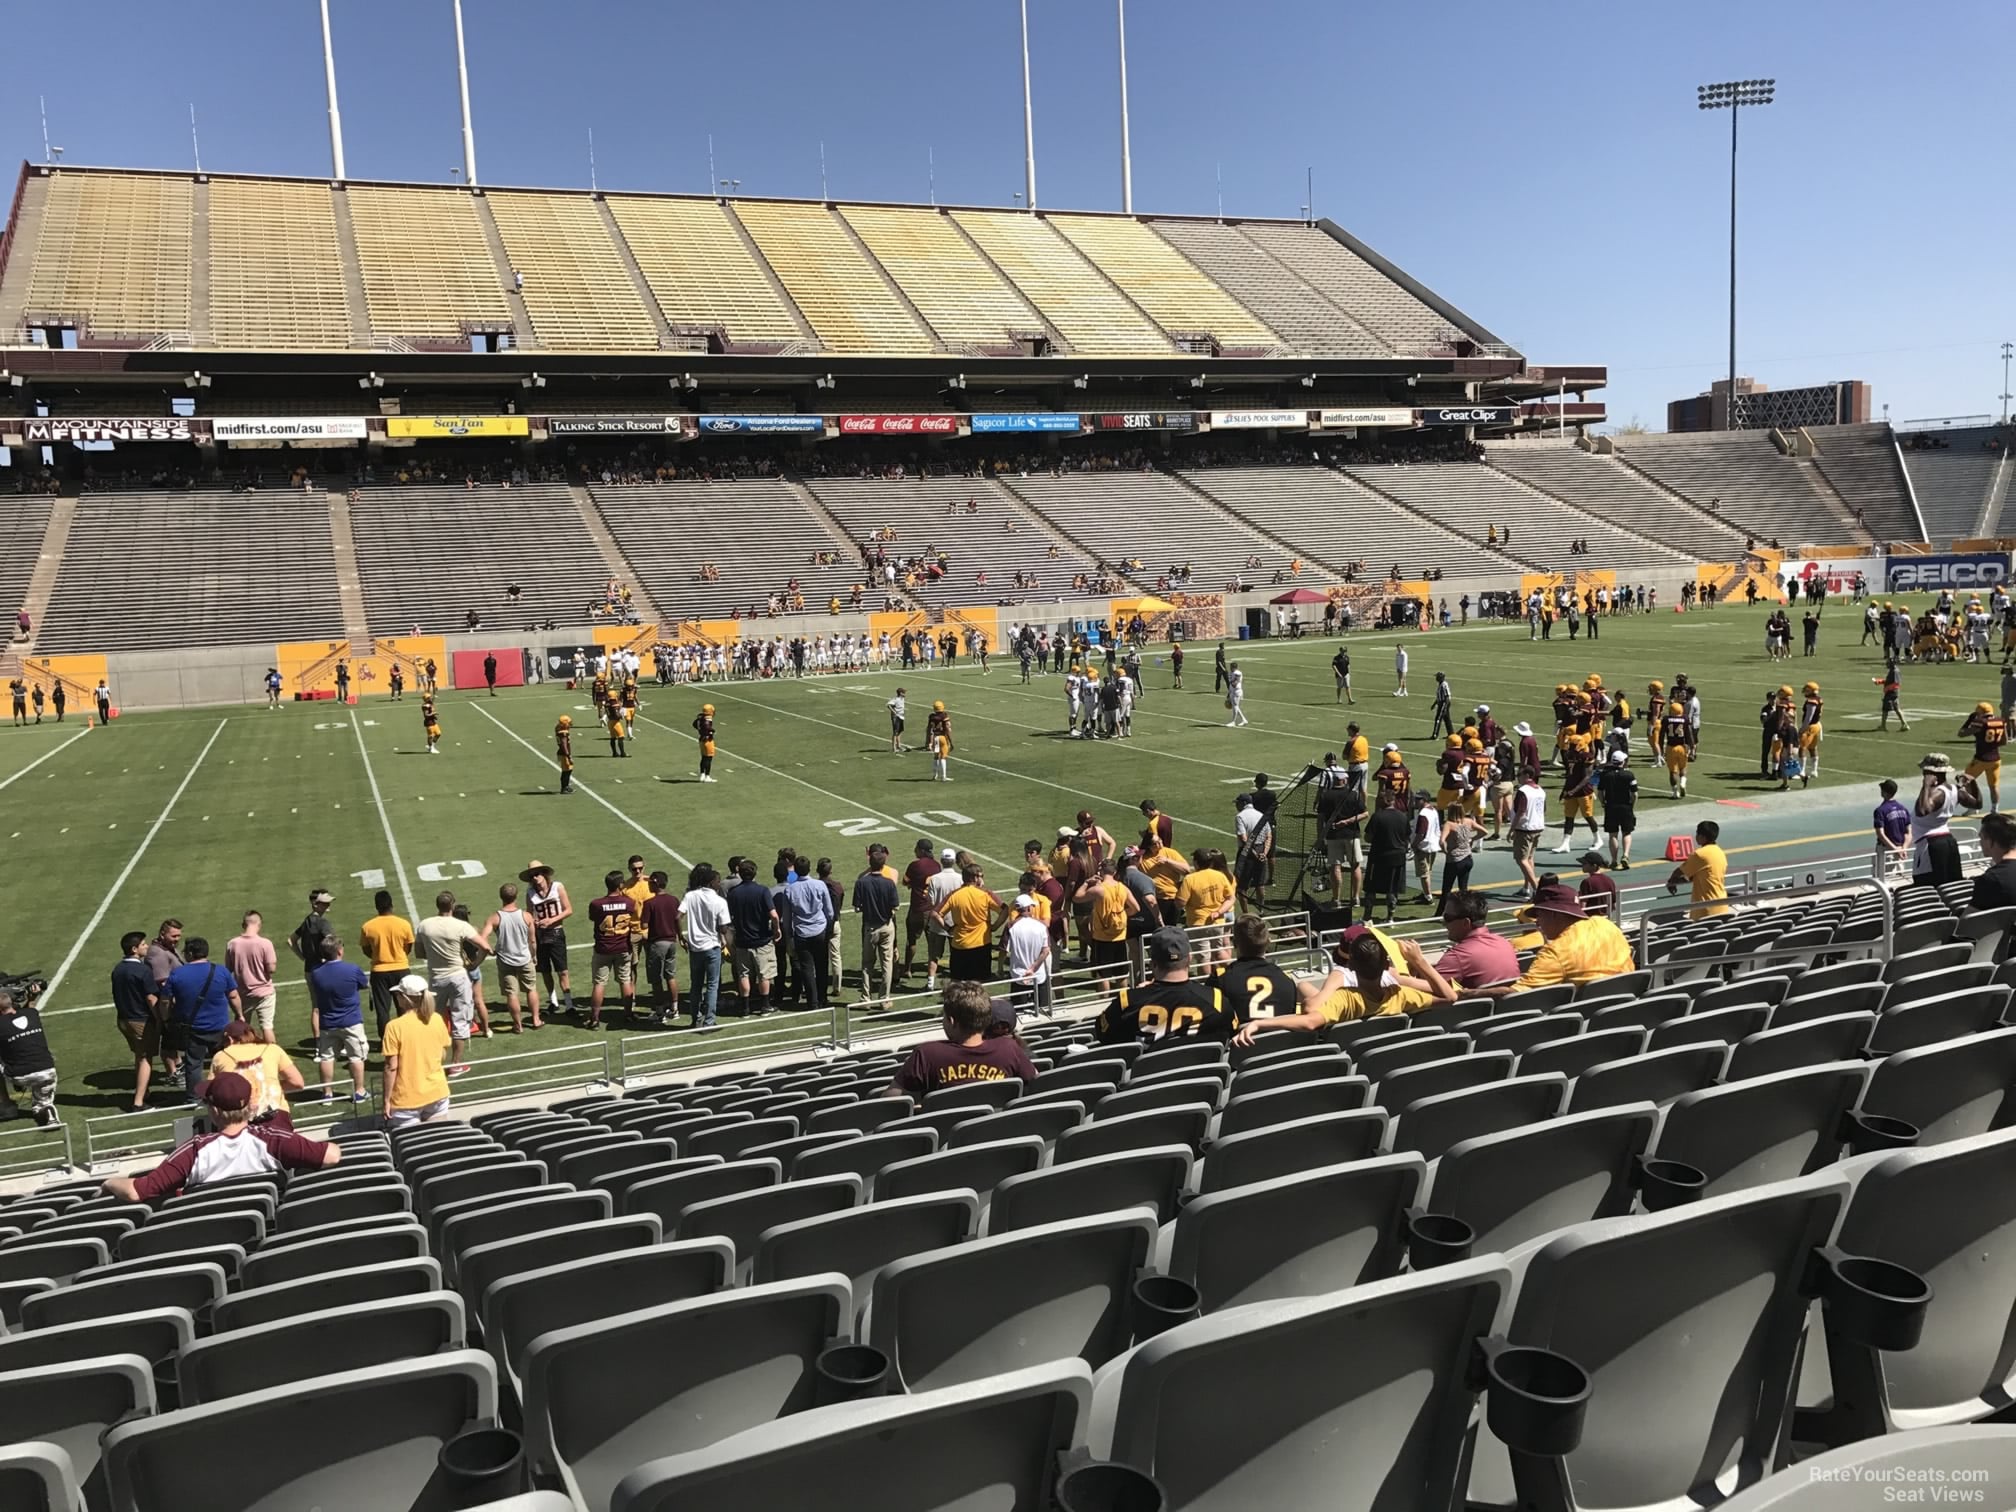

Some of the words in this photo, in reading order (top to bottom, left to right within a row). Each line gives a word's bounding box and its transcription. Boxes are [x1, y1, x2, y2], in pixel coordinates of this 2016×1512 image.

[747, 417, 772, 425] Arizona
[774, 417, 789, 425] Ford
[790, 417, 816, 425] Dealers
[973, 416, 1006, 430] Sagicor
[1008, 416, 1026, 427] Life
[1324, 414, 1386, 422] midfirst.com/asu
[1440, 410, 1470, 421] Great
[1470, 410, 1497, 423] Clips
[52, 420, 189, 429] MOUNTAINSIDE
[217, 423, 323, 435] midfirst.com/asu
[553, 421, 595, 431] TALKING
[597, 420, 625, 430] STICK
[627, 420, 663, 430] RESORT
[52, 428, 191, 440] FITNESS
[1890, 563, 2004, 584] GEICO
[1667, 723, 1685, 737] 14
[1985, 728, 2003, 743] 87
[1674, 839, 1694, 857] 30
[602, 903, 627, 911] TILLMAN
[599, 913, 631, 936] 42
[1247, 976, 1274, 1018] 2
[939, 1063, 1006, 1084] JACKSON
